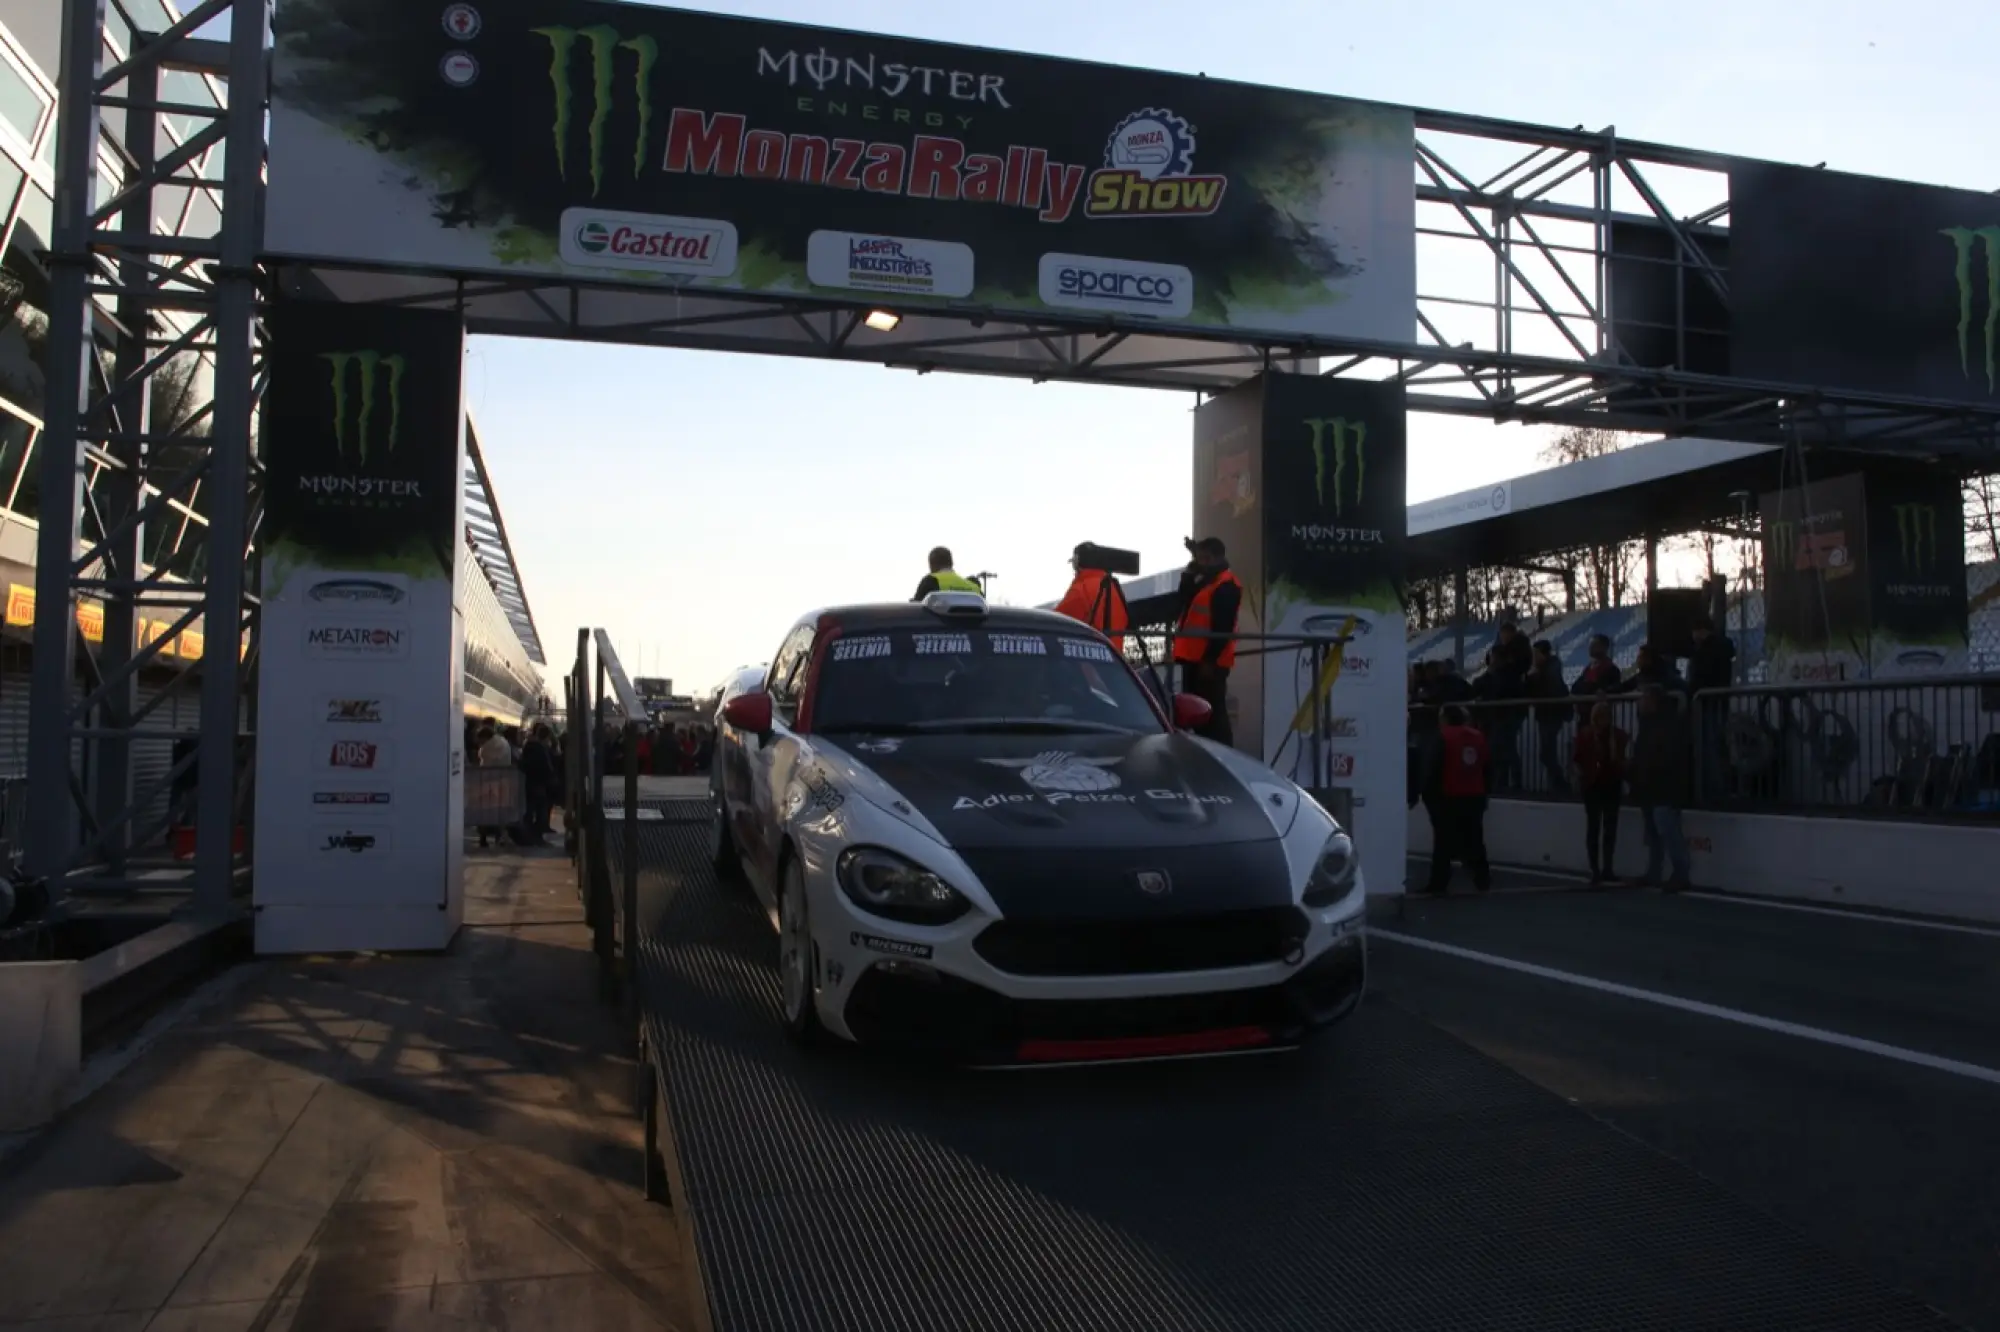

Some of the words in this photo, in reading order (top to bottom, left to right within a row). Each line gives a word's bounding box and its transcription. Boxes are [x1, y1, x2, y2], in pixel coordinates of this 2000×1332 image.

[757, 46, 1011, 109] MONSTER
[797, 97, 973, 130] ENERGY
[1128, 130, 1164, 146] MONZA
[1090, 174, 1220, 213] Show
[610, 227, 711, 260] Castrol
[1059, 268, 1173, 299] sparco
[299, 475, 422, 498] MONSTER
[1291, 524, 1384, 544] MONSTER
[308, 627, 400, 645] METATRON
[337, 742, 370, 767] RDS
